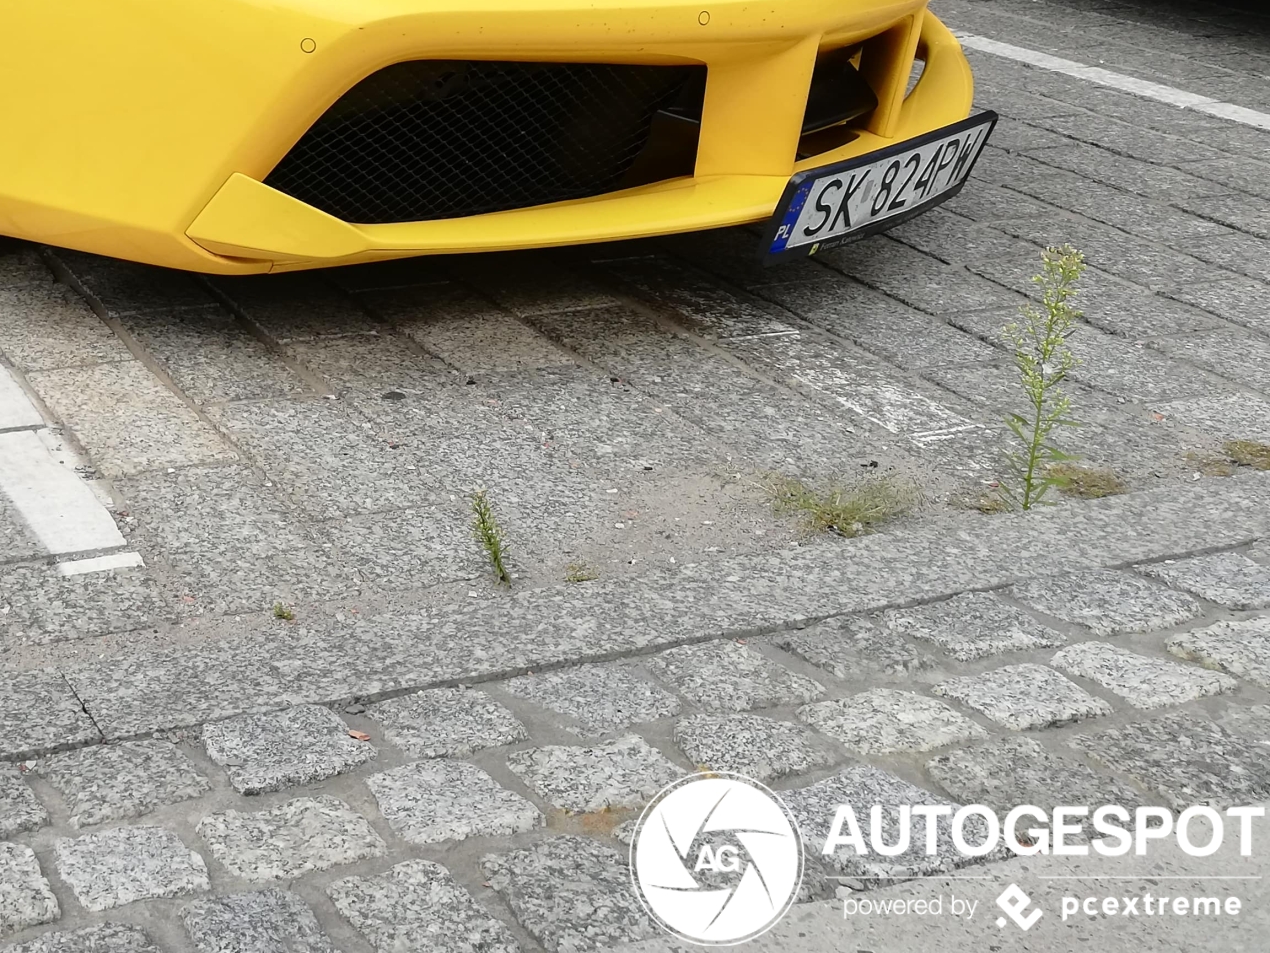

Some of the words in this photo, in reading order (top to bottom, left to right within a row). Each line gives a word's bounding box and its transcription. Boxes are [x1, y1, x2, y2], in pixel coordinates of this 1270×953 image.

[803, 169, 871, 236] SK
[870, 128, 983, 217] 824PW
[774, 224, 789, 241] PL
